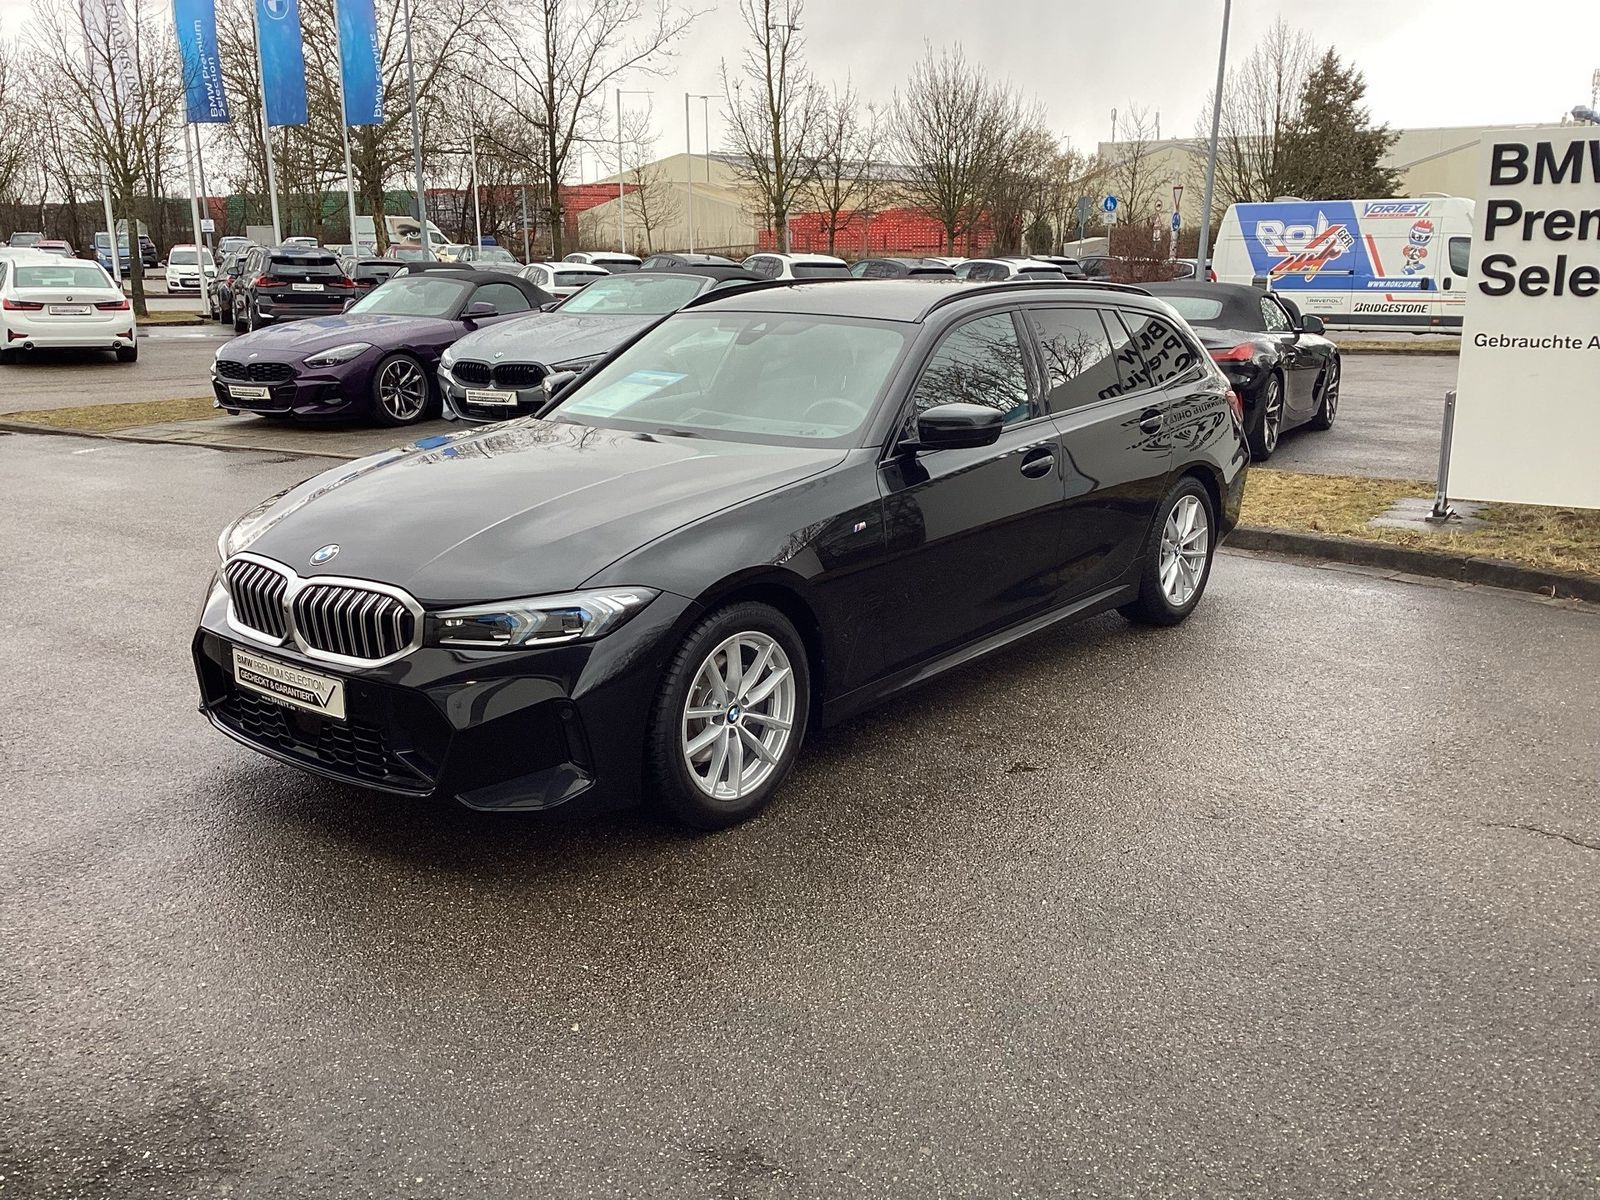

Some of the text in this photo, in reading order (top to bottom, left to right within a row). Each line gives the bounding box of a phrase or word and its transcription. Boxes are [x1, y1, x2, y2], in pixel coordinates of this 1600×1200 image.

[194, 19, 218, 117] BMW Premium
[208, 56, 226, 117] Selection
[373, 84, 383, 118] BMW
[1490, 140, 1600, 186] BM
[1337, 229, 1354, 247] GER
[1353, 302, 1429, 314] BRIDGESTONE
[1474, 333, 1582, 349] Gebrauchte
[236, 654, 253, 668] BMW
[253, 659, 284, 679] PREMIUM
[240, 669, 315, 703] GECHECKT & GARANTIERT
